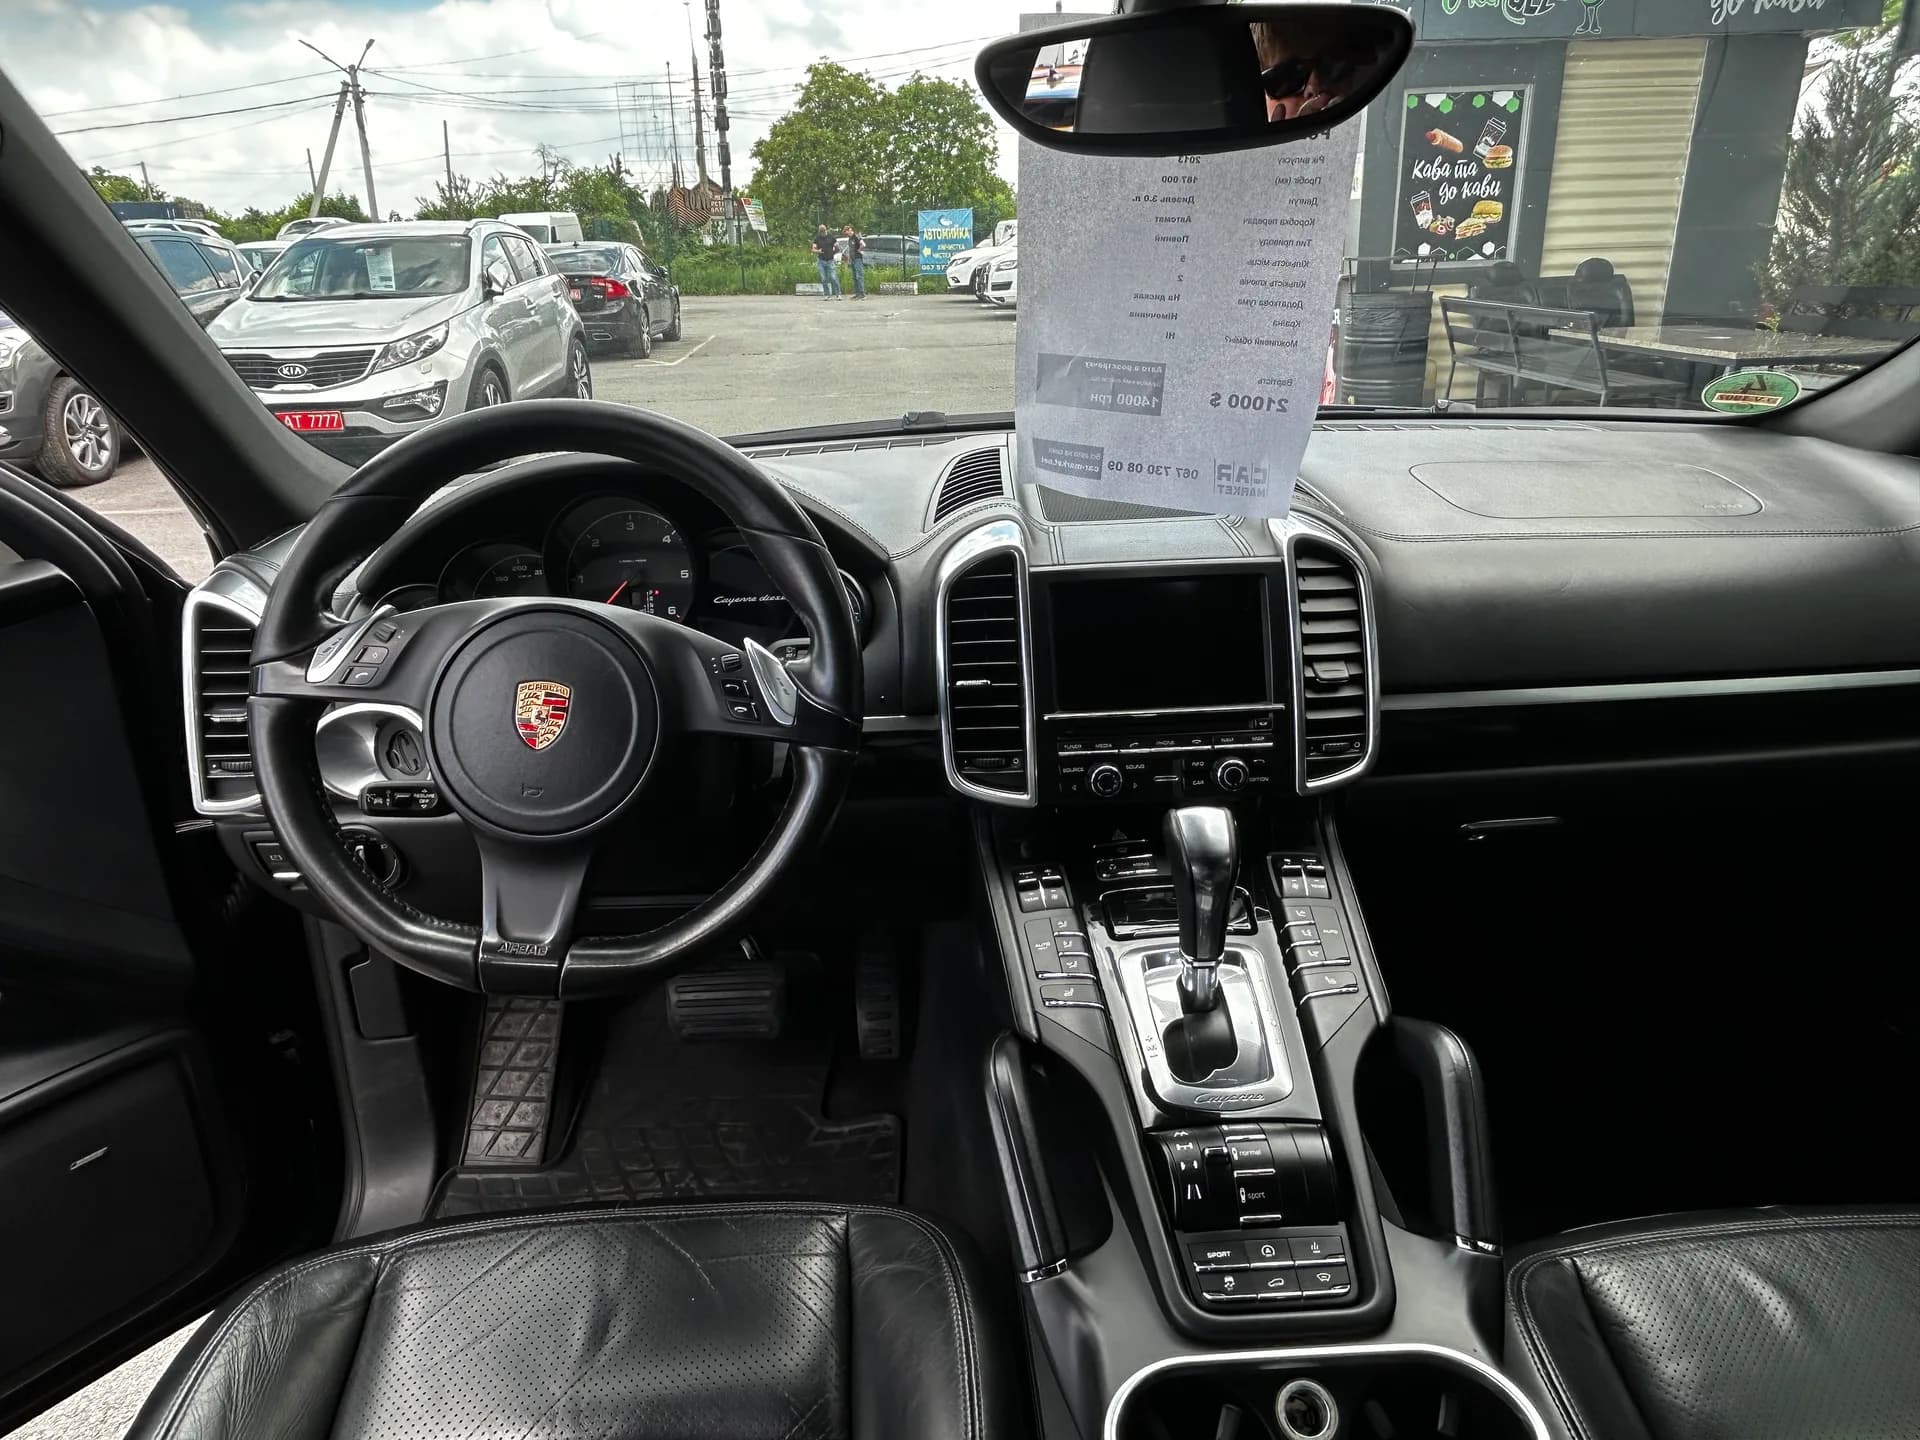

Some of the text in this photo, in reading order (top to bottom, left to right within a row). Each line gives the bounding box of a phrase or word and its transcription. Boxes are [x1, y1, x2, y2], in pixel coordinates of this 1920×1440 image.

[1412, 155, 1478, 180] Кава та
[1439, 174, 1501, 205] до кави
[924, 225, 970, 240] АВТОМИЙКА
[282, 366, 301, 375] KIA
[308, 414, 338, 428] 7777
[626, 522, 634, 530] 3
[662, 535, 672, 543] 4
[680, 570, 689, 578] 5
[713, 595, 757, 606] Cayenne
[668, 606, 676, 615] 6
[1193, 1093, 1265, 1109] Cayenne
[1247, 1191, 1266, 1200] sport
[1207, 1250, 1232, 1258] SPORT
